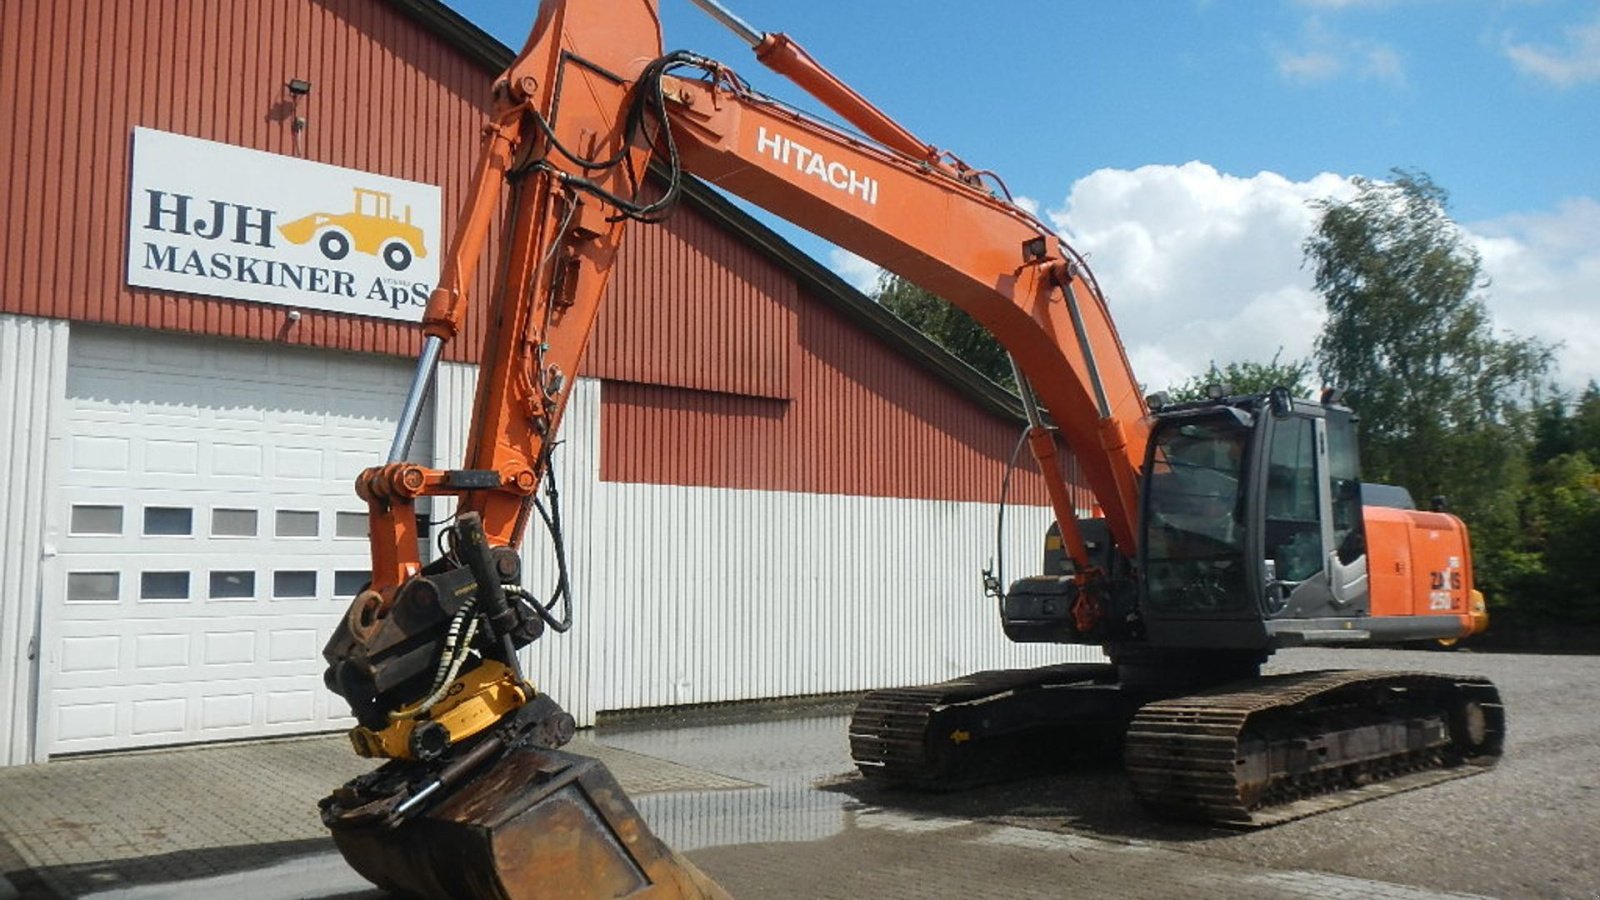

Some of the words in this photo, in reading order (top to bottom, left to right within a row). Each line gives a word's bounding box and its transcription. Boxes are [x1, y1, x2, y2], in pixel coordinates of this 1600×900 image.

[757, 126, 878, 205] HITACHI
[143, 188, 277, 248] HJH
[143, 242, 357, 297] MASKINER
[366, 276, 430, 310] ApS
